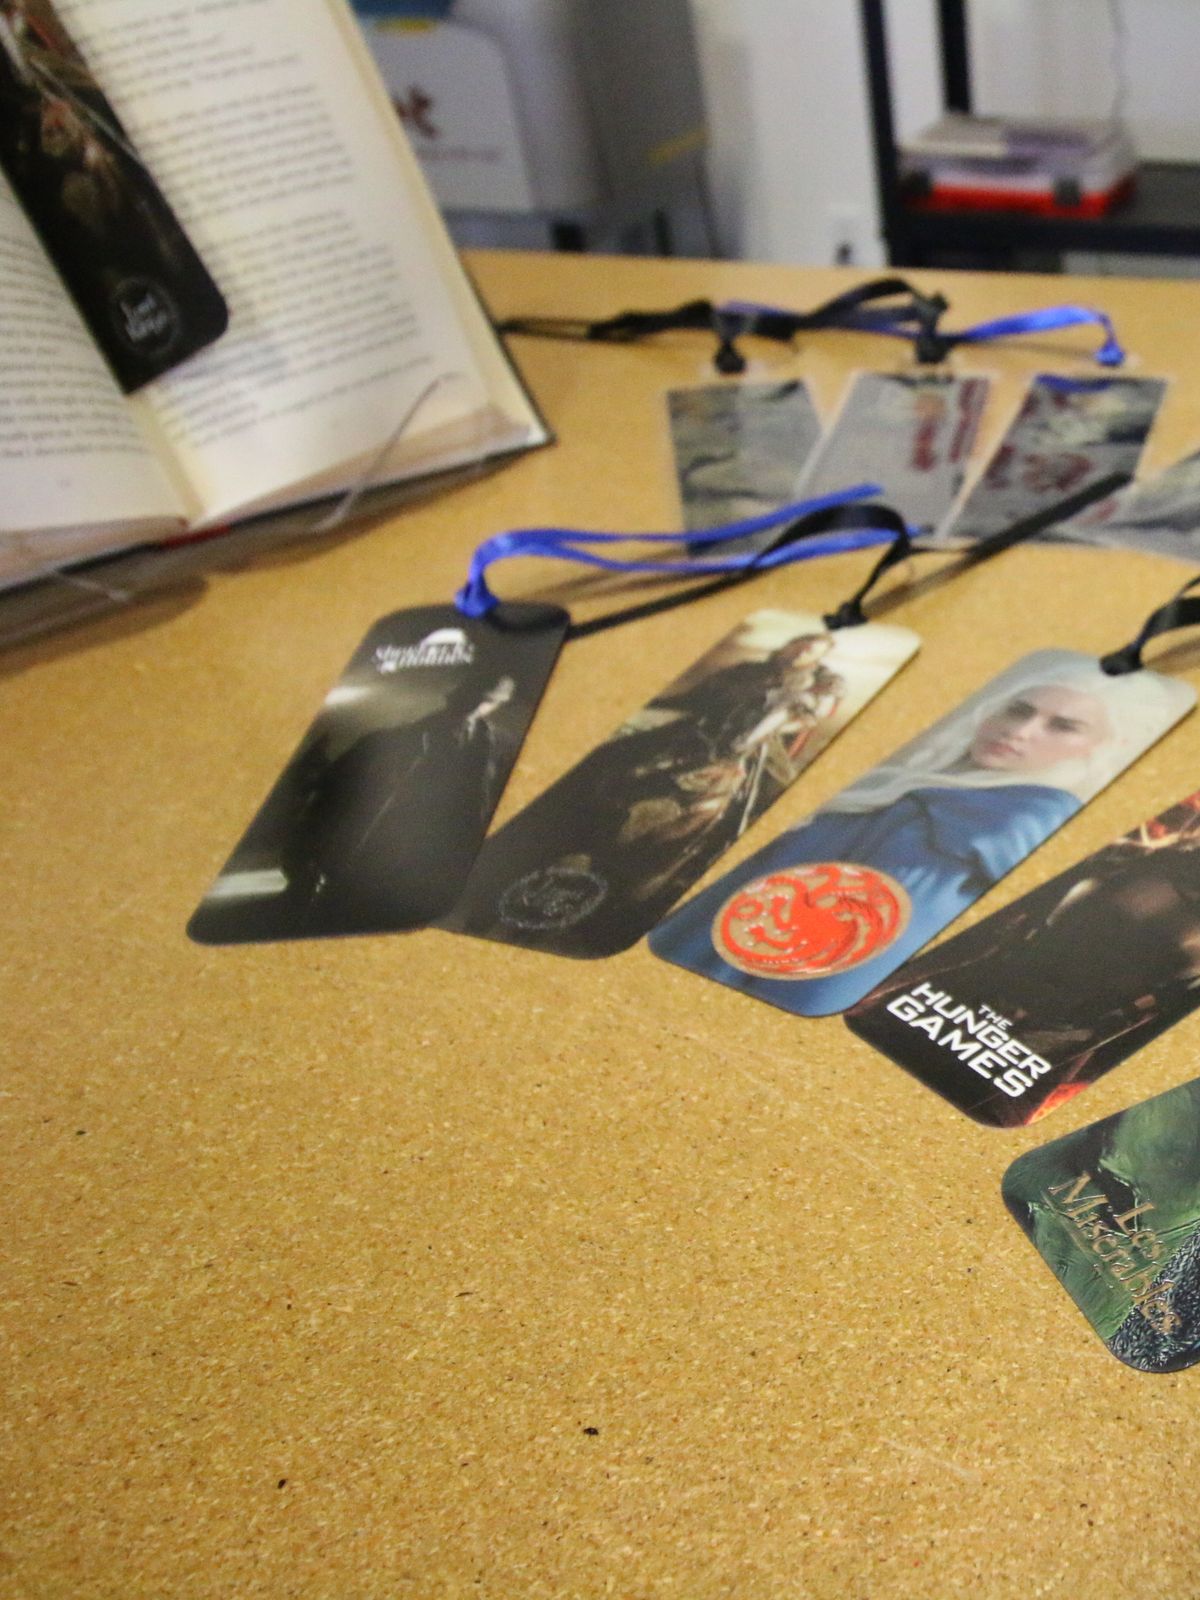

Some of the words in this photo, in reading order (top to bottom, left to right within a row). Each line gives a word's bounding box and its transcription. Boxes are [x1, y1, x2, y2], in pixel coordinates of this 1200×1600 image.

[886, 994, 1034, 1098] GAMES
[910, 982, 1052, 1080] HUNGER
[978, 1004, 1013, 1031] THE
[1112, 1201, 1165, 1260] Les
